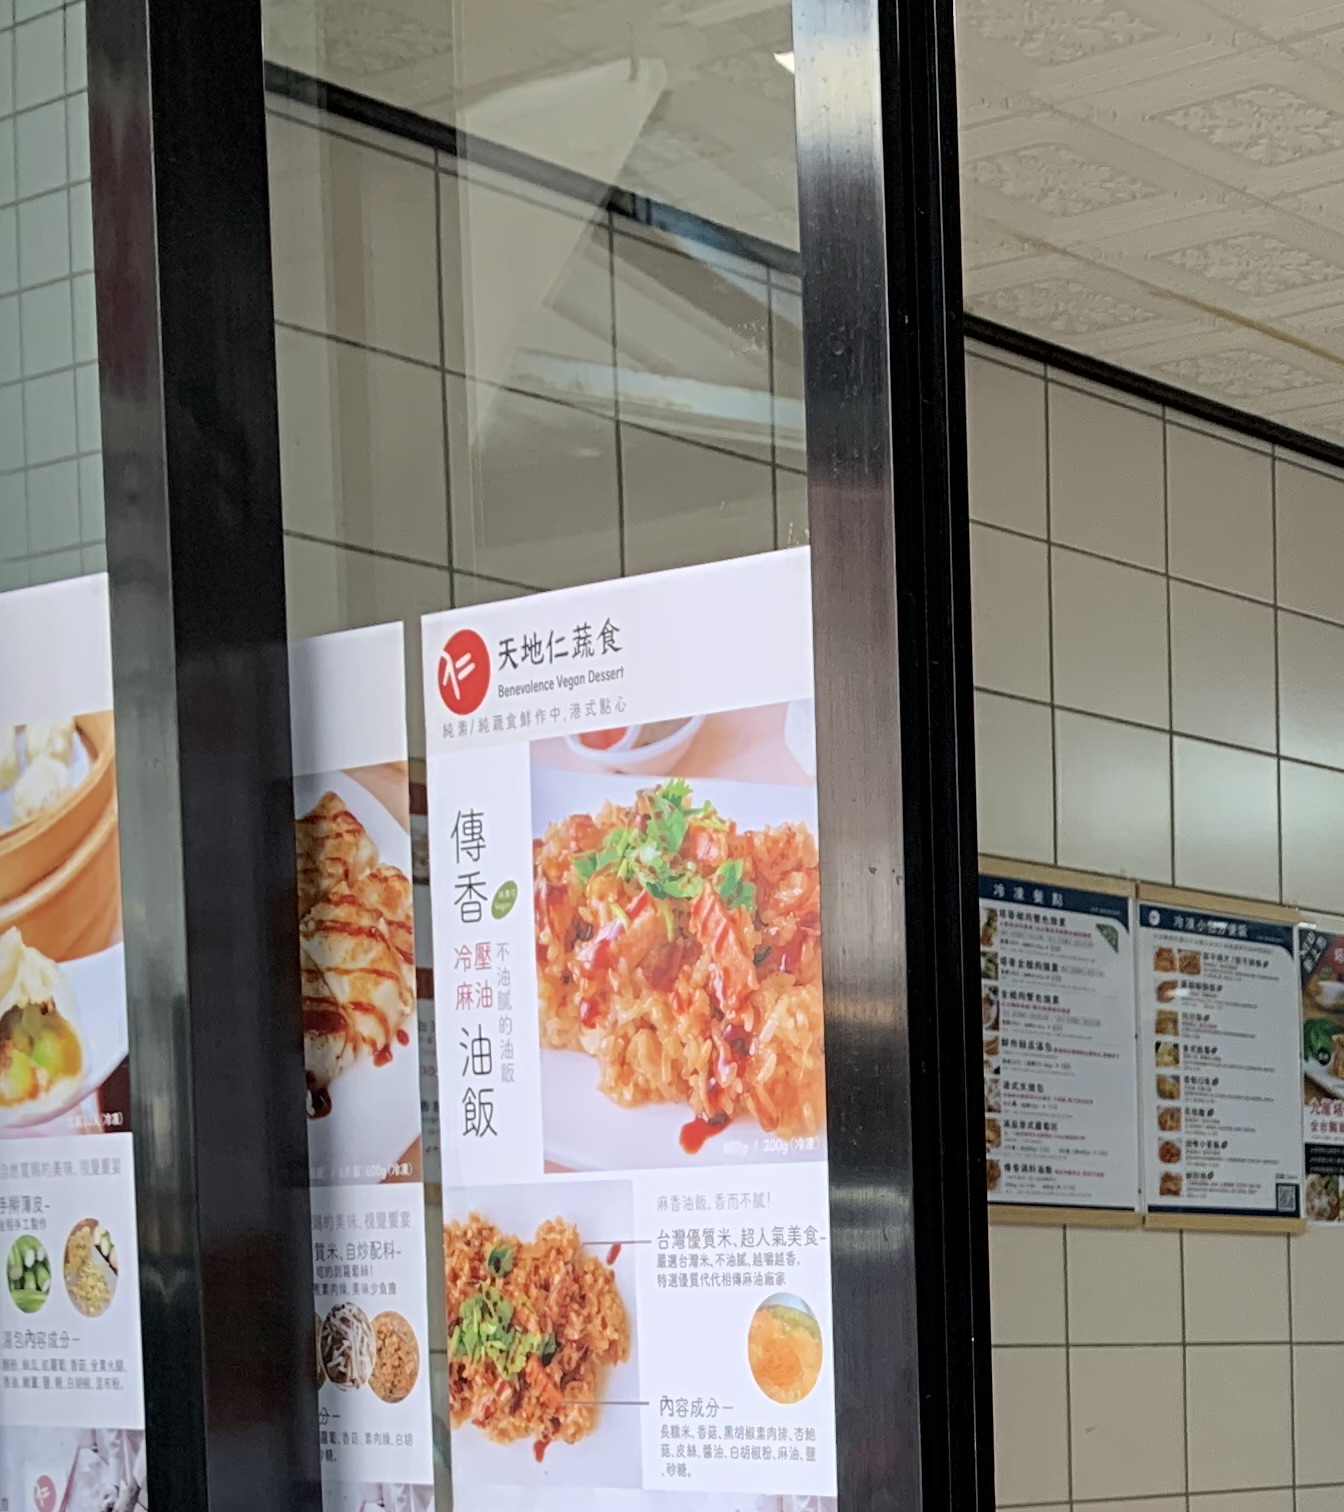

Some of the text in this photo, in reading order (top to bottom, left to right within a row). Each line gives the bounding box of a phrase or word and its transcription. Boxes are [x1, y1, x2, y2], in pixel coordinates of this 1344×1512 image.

[497, 616, 624, 672] 天地仁蔬食
[497, 665, 625, 699] Benevolence Vegan Dessert
[451, 808, 488, 924] 傳香
[458, 1024, 499, 1138] 油飯
